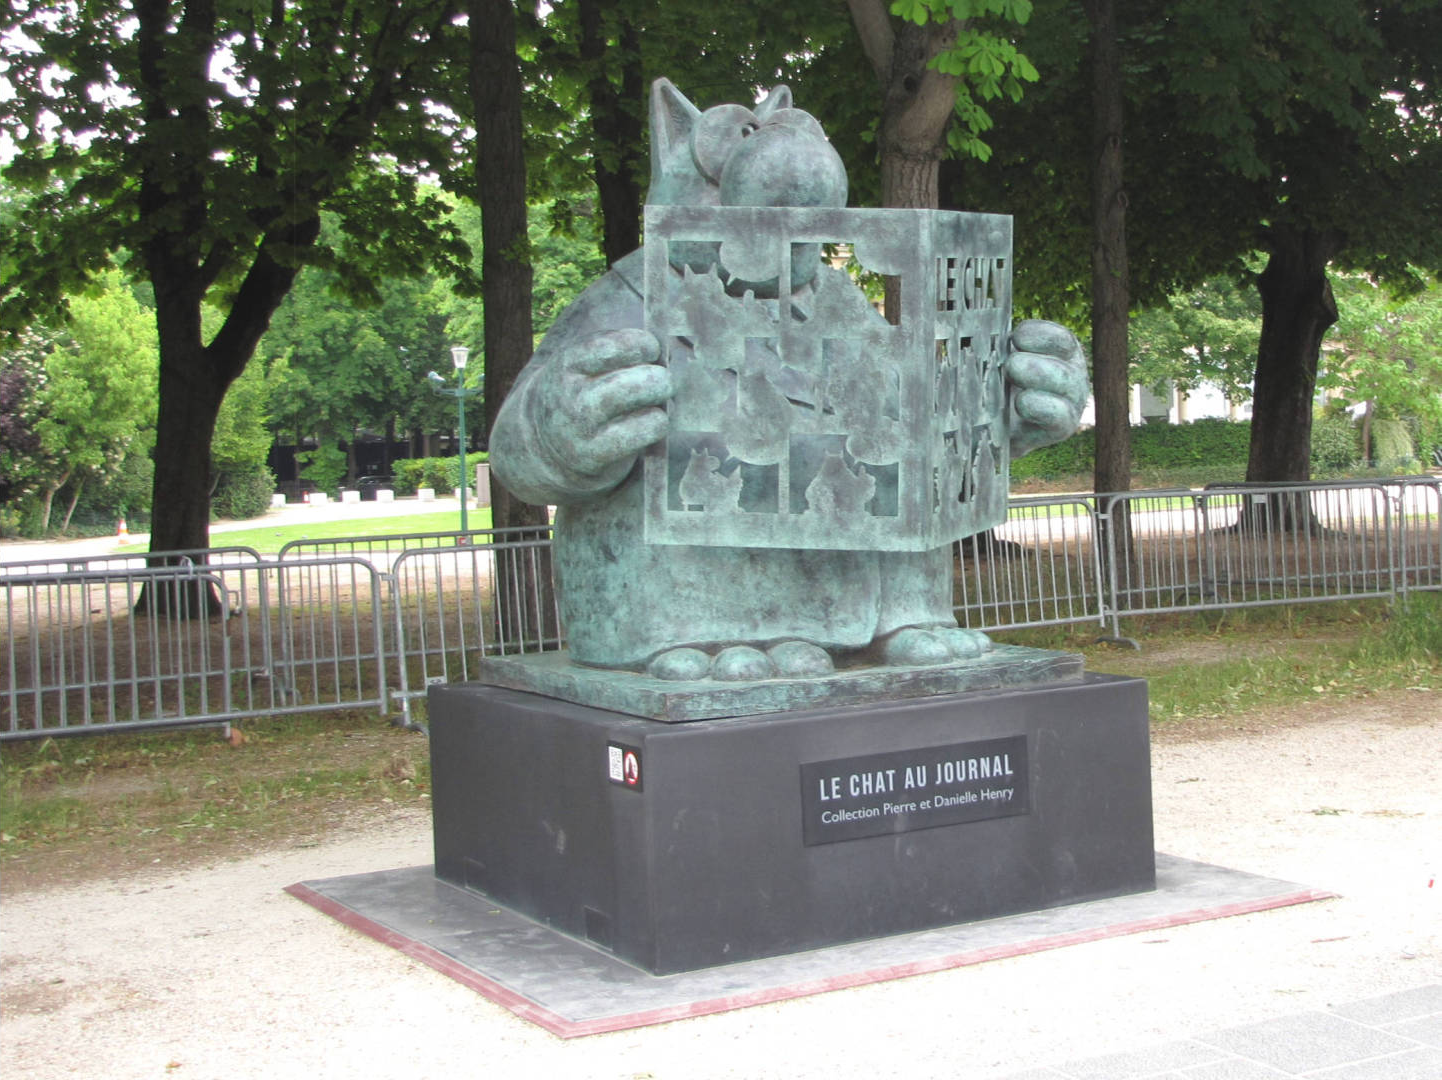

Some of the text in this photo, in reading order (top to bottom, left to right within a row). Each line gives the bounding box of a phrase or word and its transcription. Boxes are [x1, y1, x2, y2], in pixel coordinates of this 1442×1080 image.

[936, 256, 1006, 311] LE CHAT
[819, 754, 1014, 801] LE CHAT AU JOURNAL
[821, 787, 1014, 824] Collection Pierre et Danielle Henry
